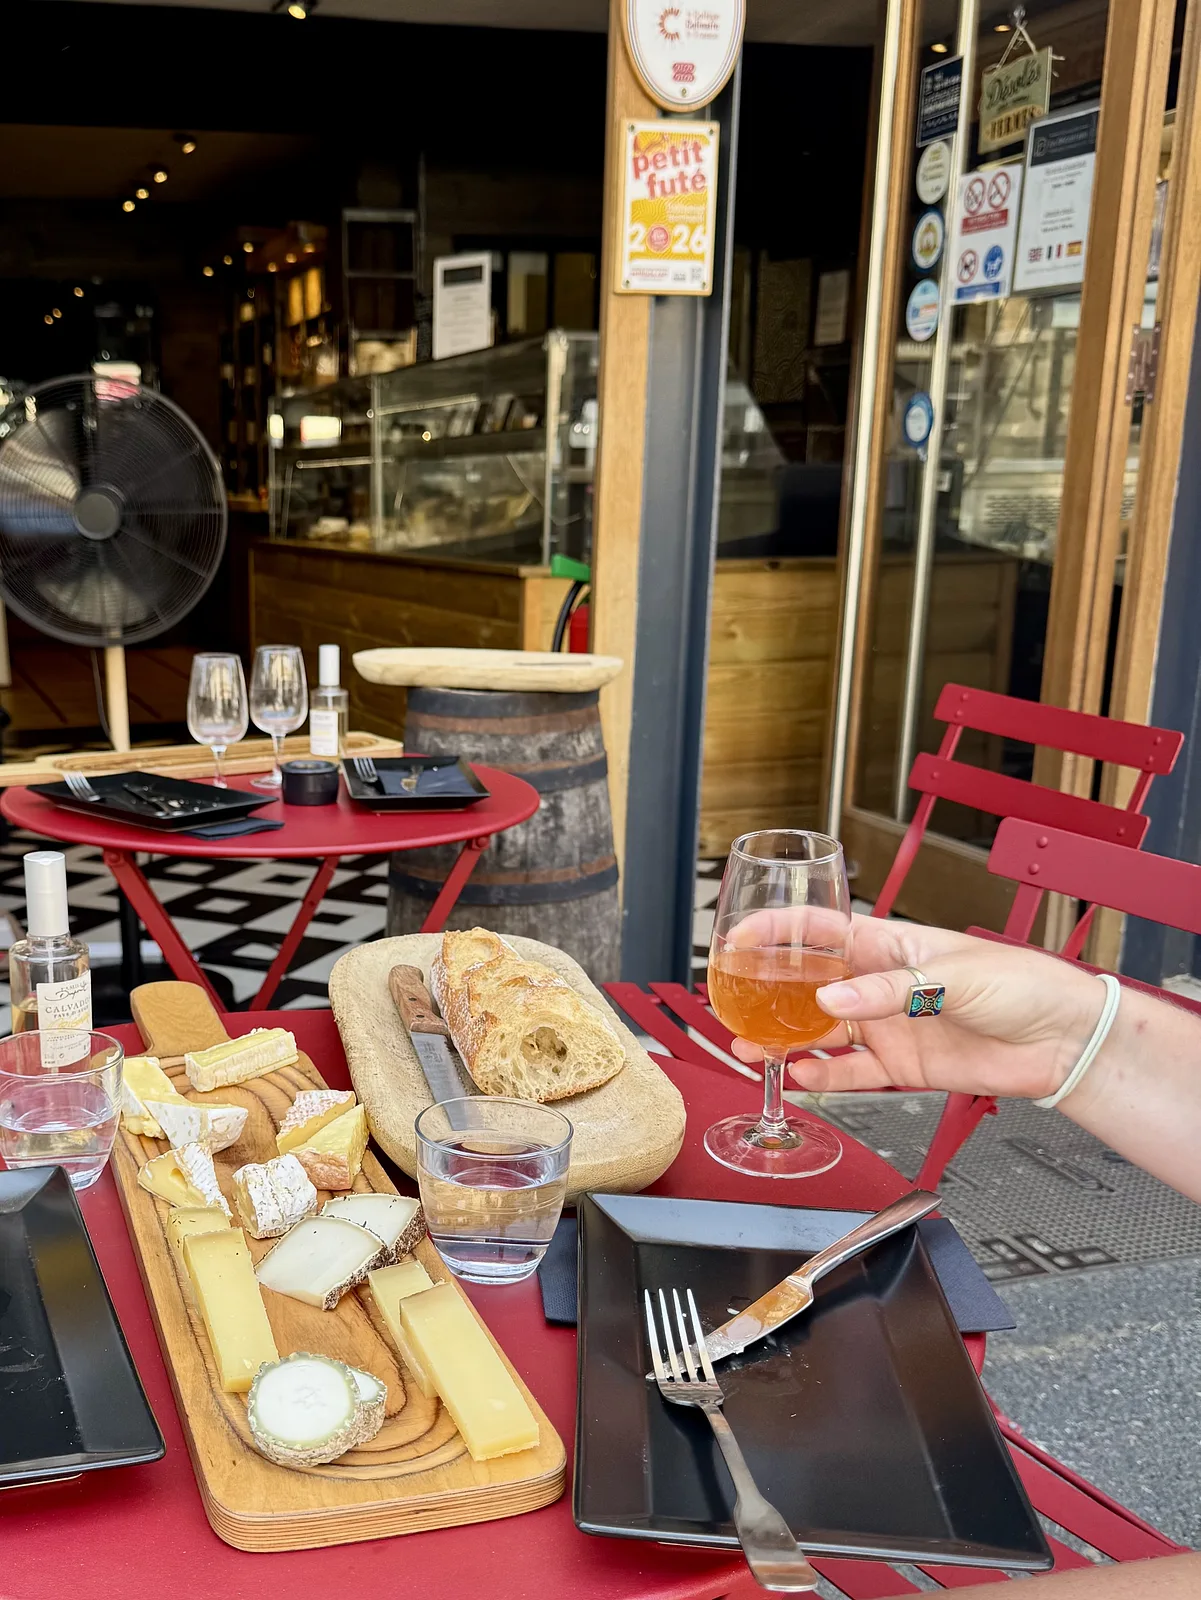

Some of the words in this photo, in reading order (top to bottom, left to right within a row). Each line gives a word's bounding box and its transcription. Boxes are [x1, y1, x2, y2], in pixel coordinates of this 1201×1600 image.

[632, 140, 704, 180] petit
[646, 168, 706, 201] futé
[45, 996, 90, 1014] CALVADO
